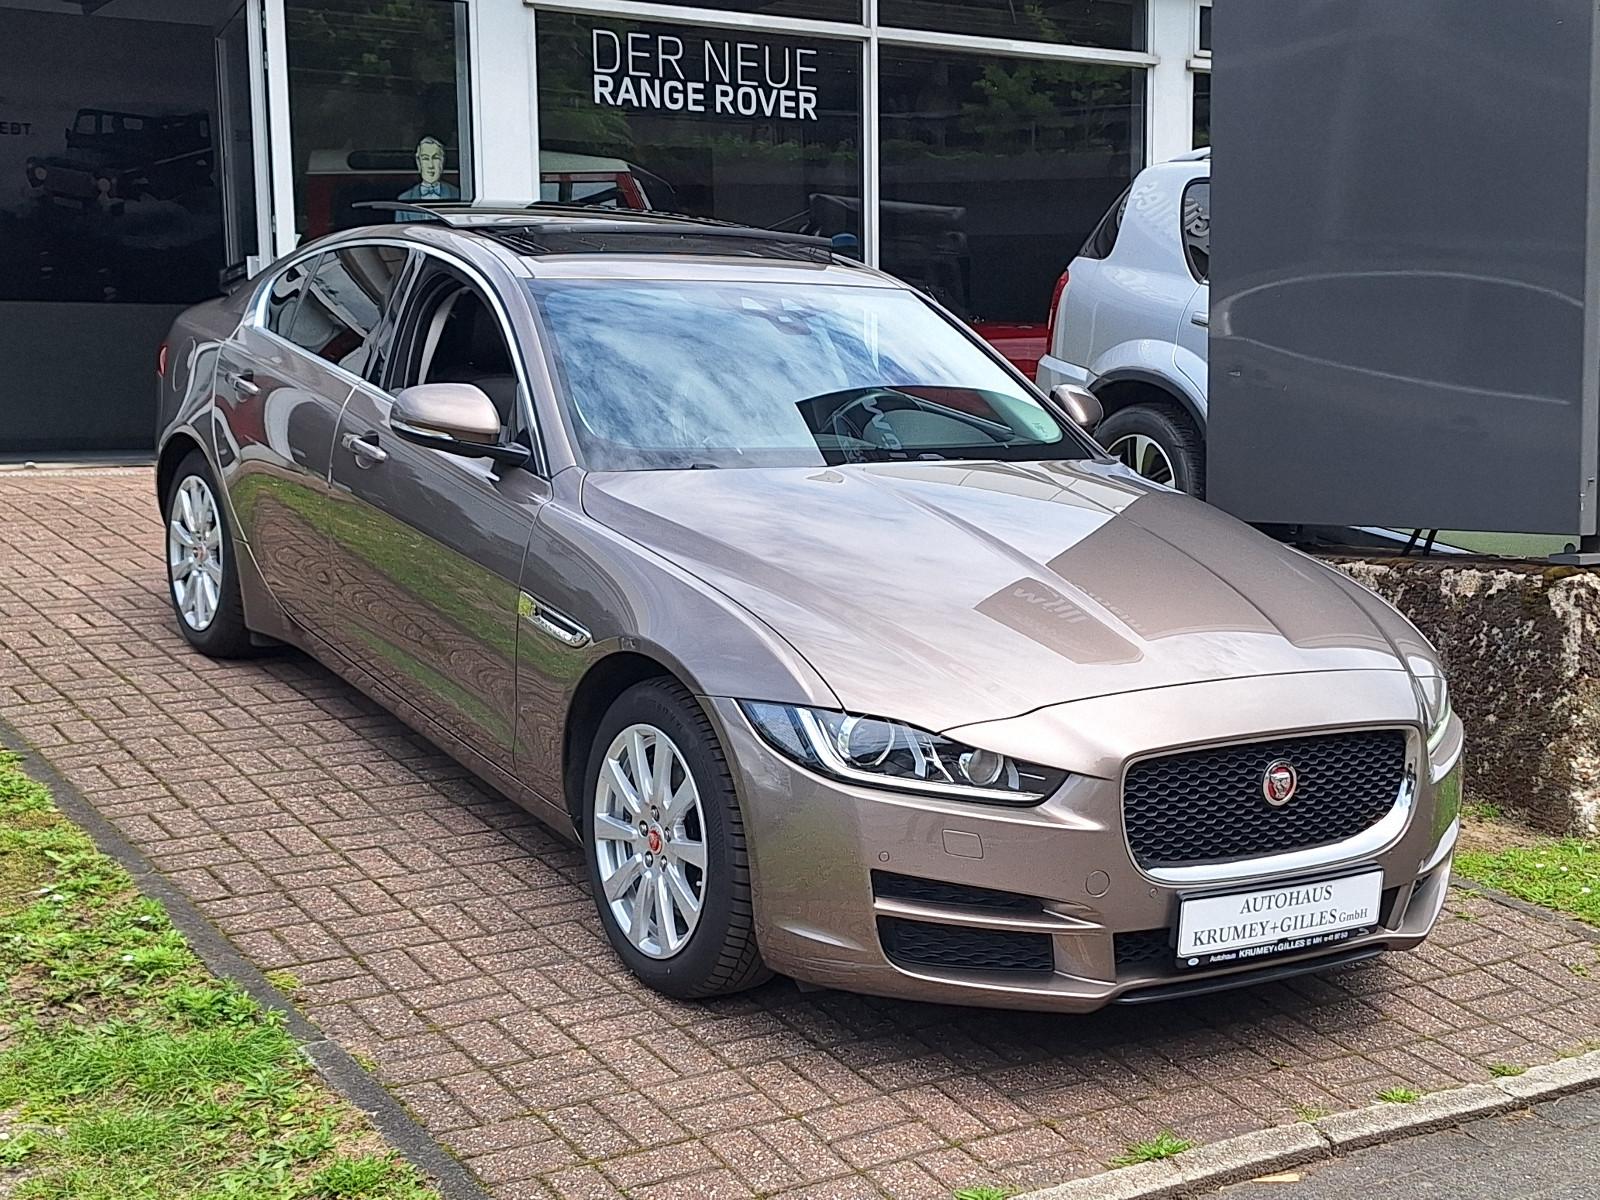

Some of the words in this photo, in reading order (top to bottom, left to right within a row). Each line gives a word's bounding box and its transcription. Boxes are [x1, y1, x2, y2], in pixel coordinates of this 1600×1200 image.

[592, 29, 685, 80] DER
[704, 39, 817, 91] NEUE
[593, 74, 705, 112] RANGE
[715, 84, 818, 121] ROVER
[1240, 885, 1333, 914] AUTOHAUS
[1192, 908, 1337, 947] KRUMEY+GILLES
[1339, 908, 1369, 923] GmbH
